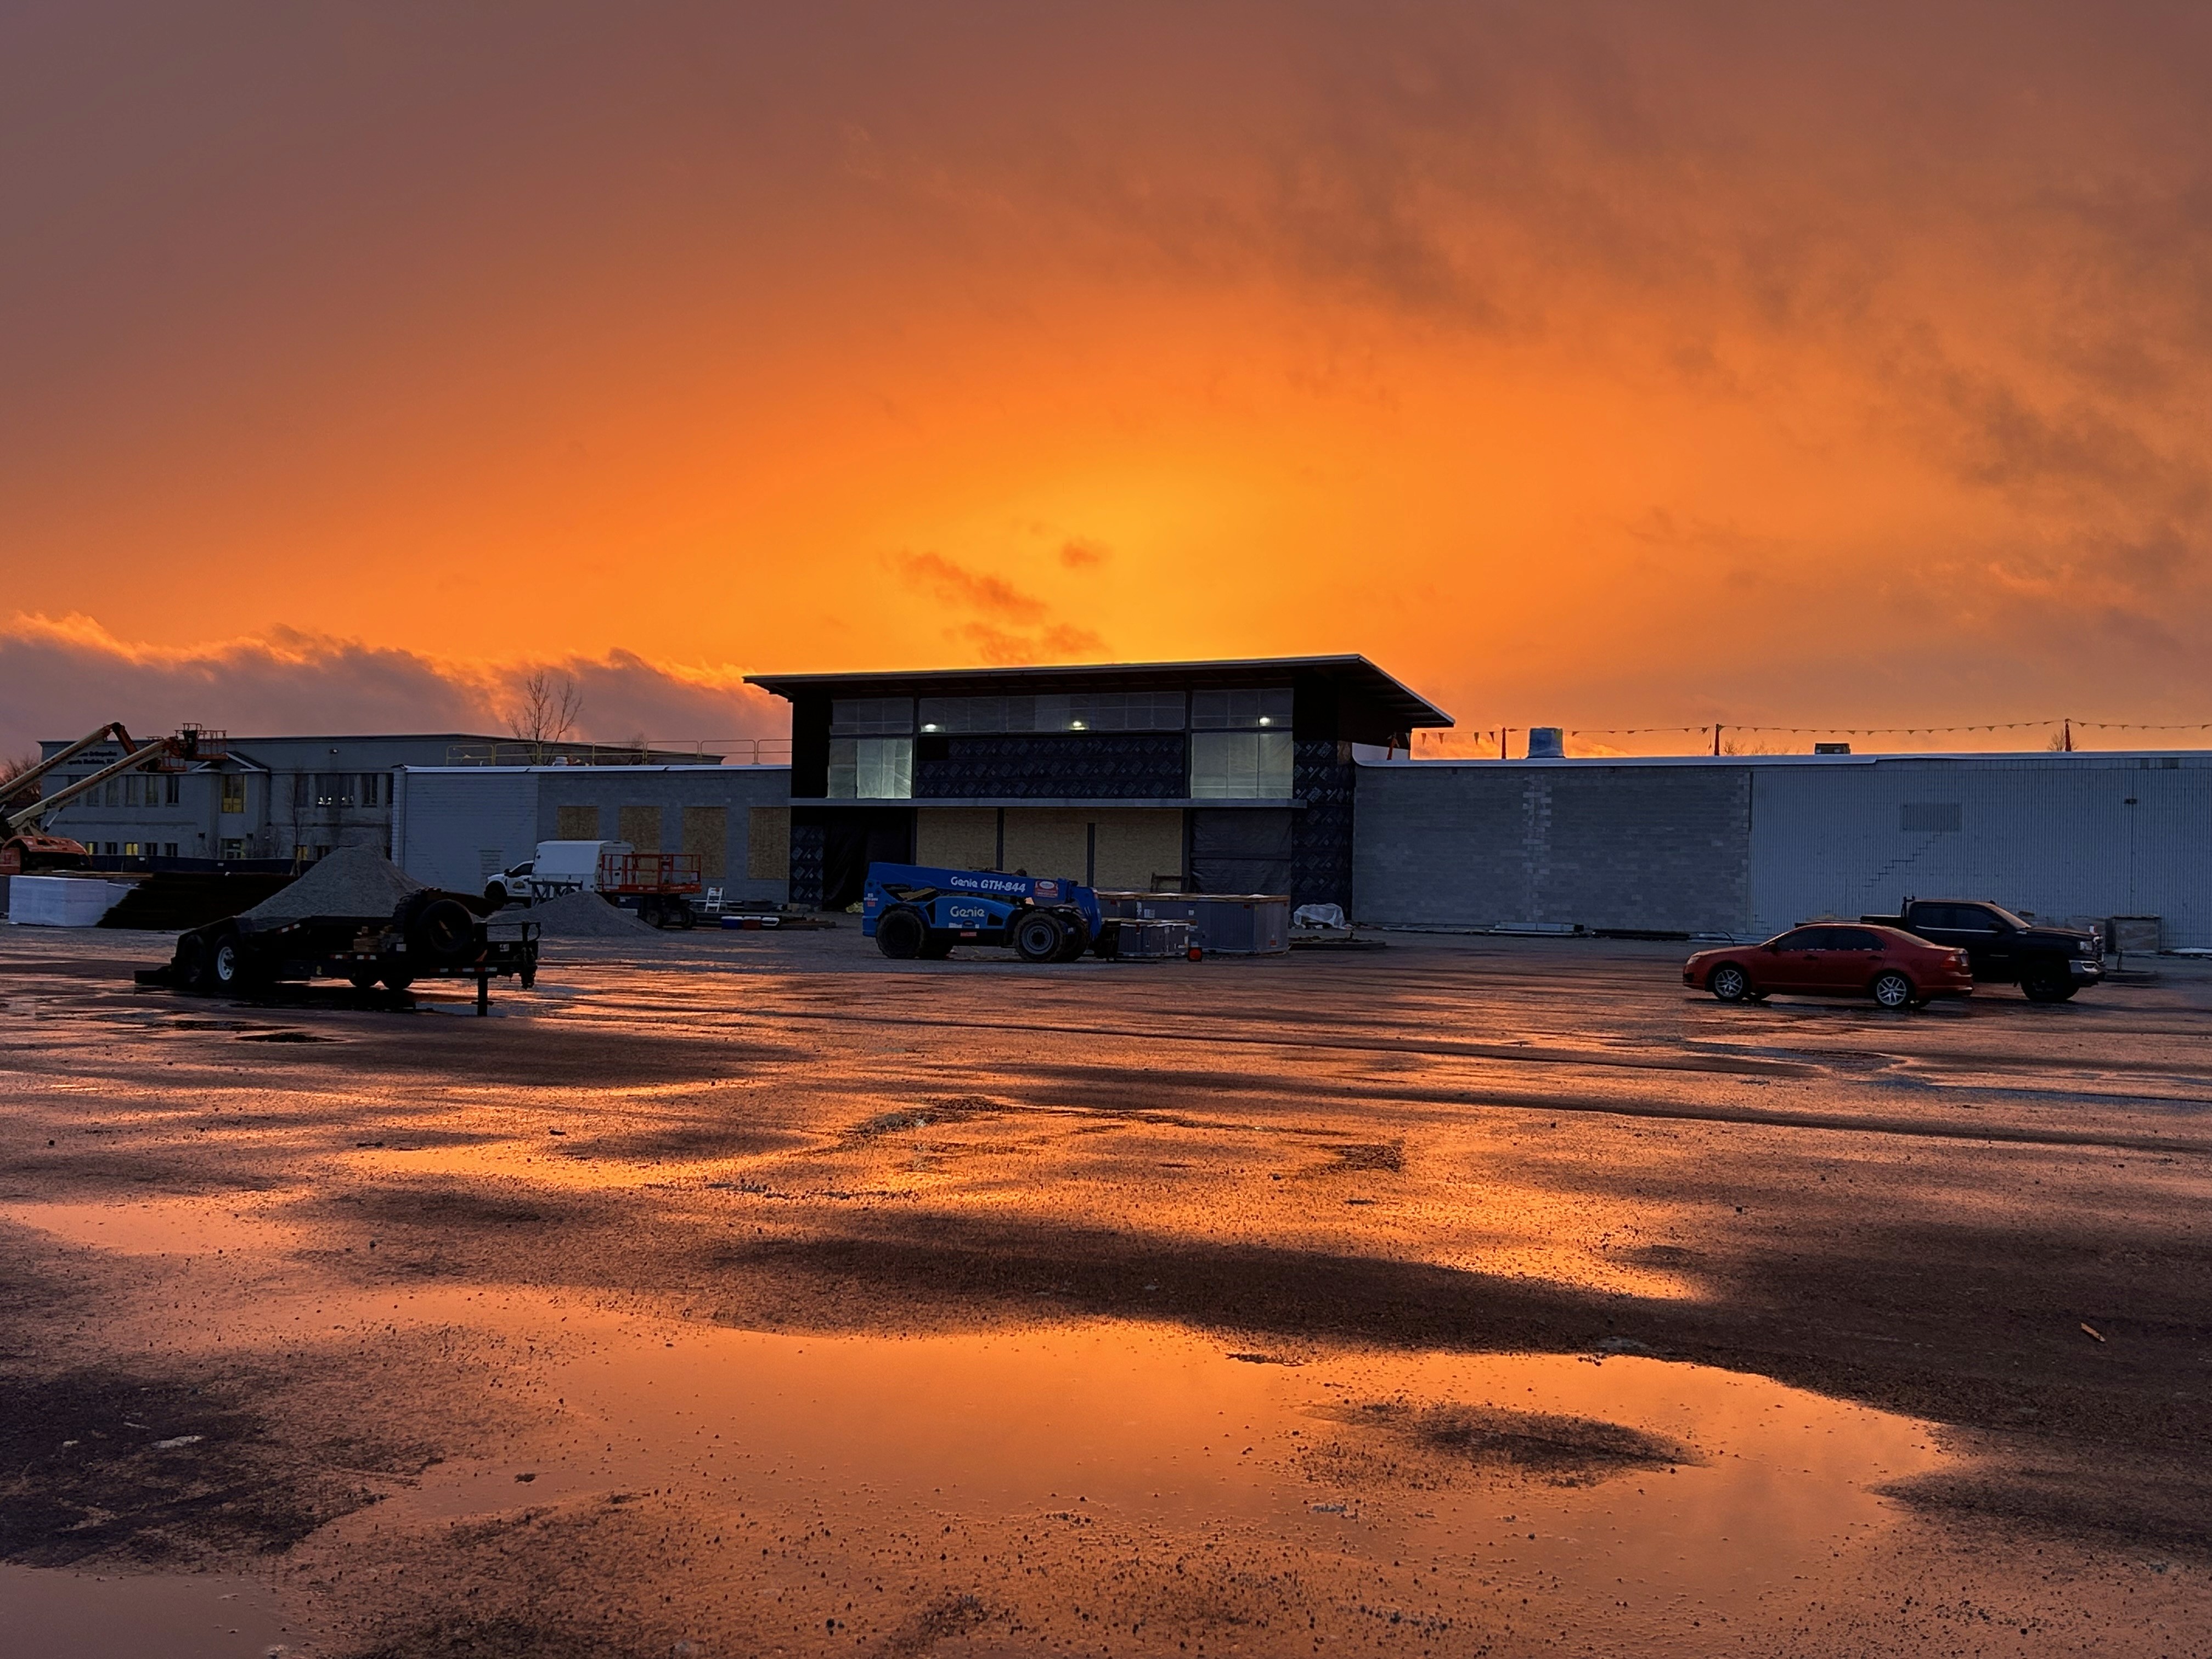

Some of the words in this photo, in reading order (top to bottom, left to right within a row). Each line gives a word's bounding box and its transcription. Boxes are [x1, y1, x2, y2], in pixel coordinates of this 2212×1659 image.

[950, 876, 978, 888] Genie
[980, 879, 1025, 893] GTH-844
[950, 906, 985, 917] Genie
